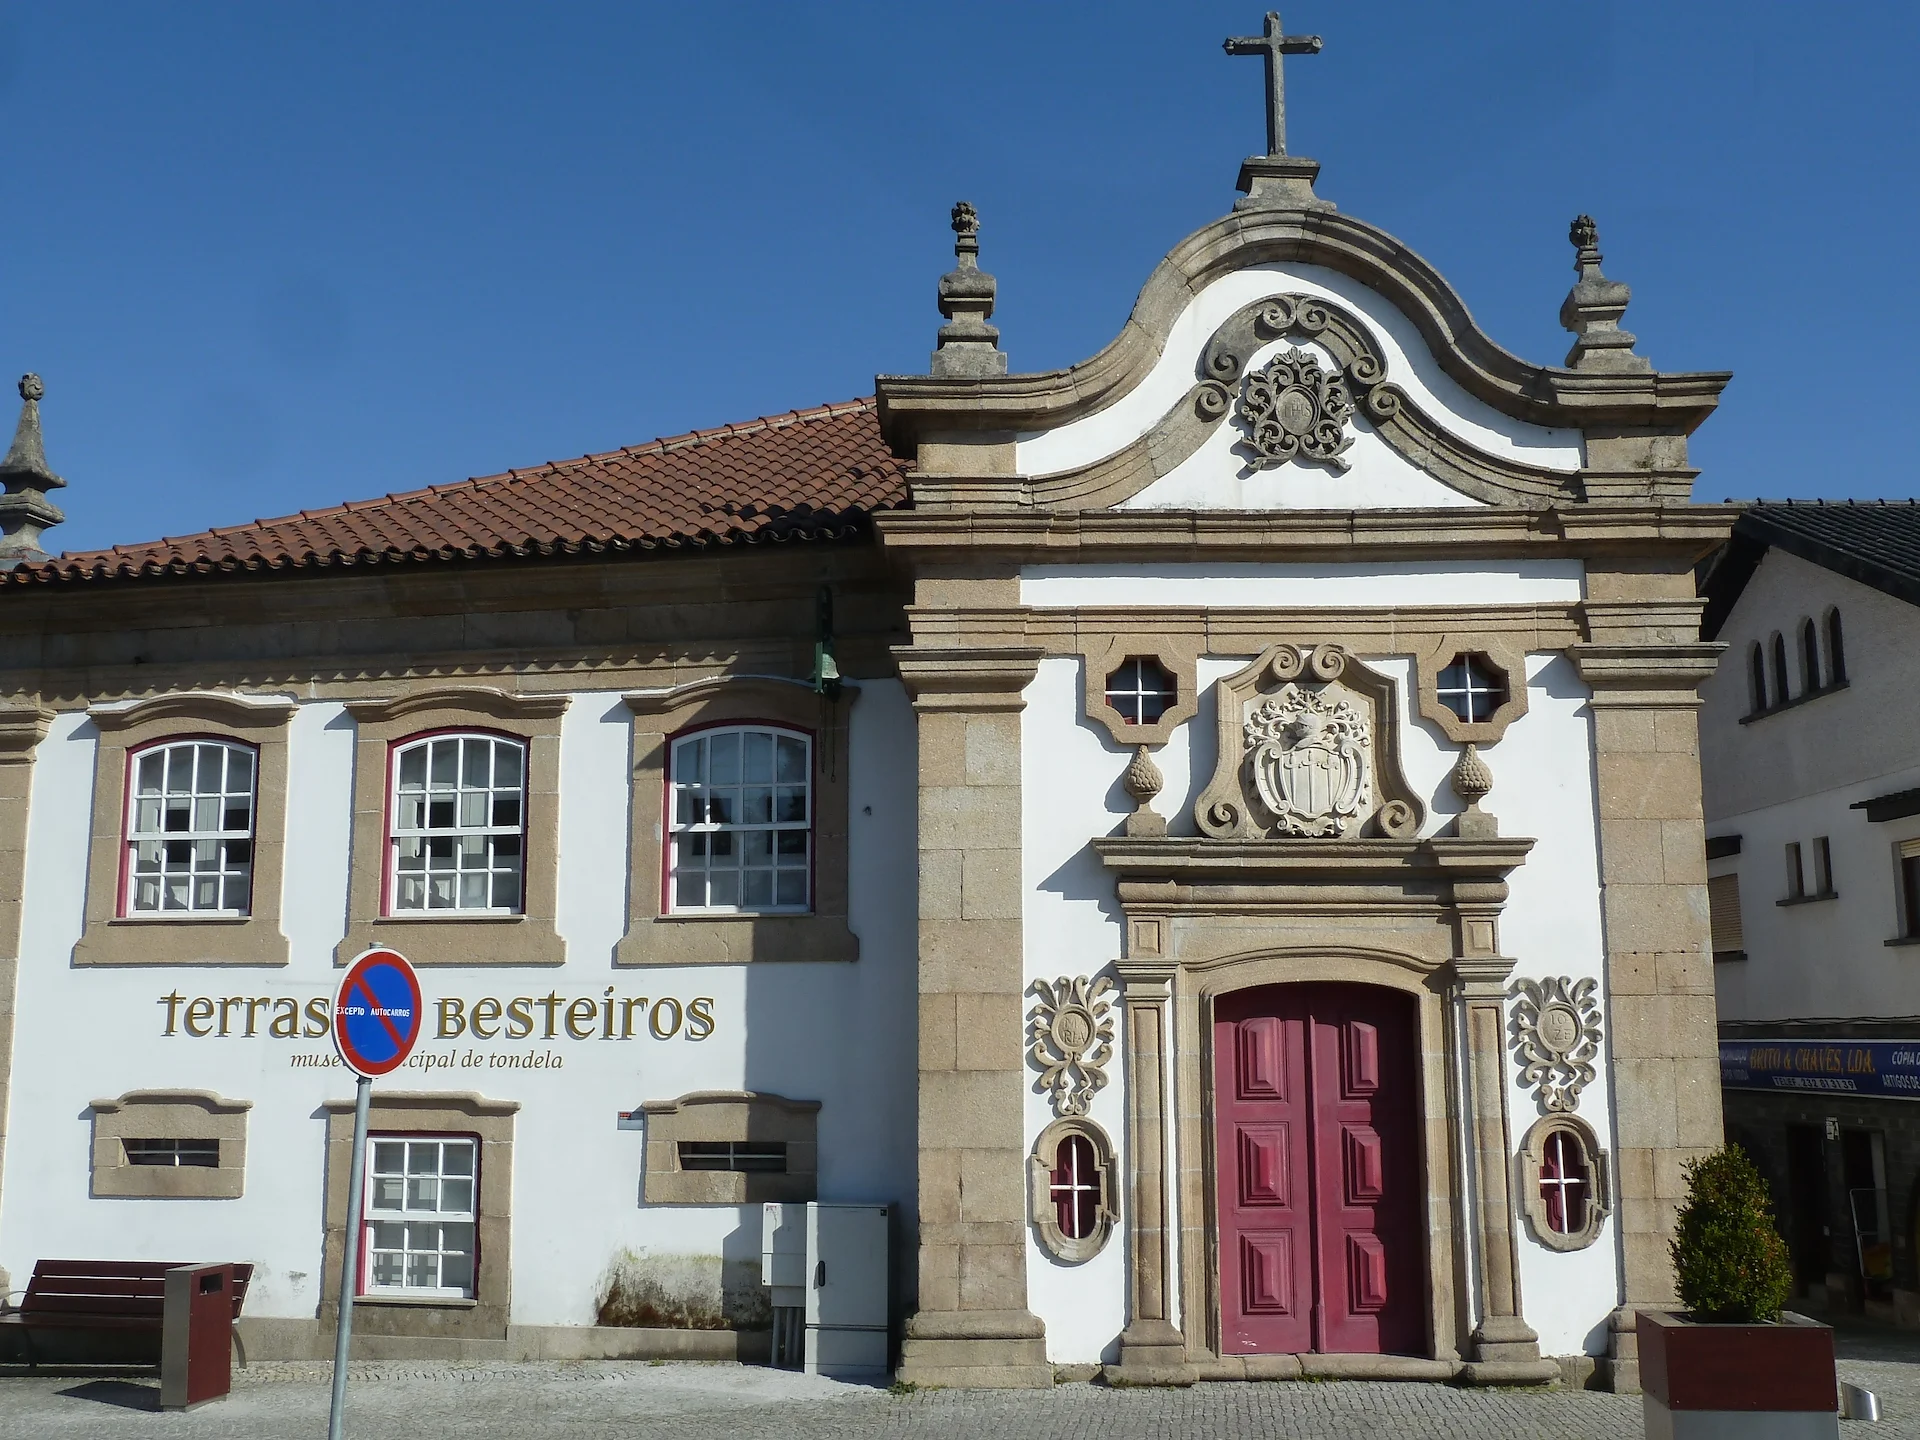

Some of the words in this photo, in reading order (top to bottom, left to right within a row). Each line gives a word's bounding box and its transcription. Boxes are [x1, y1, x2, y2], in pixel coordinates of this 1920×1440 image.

[157, 989, 330, 1038] terras
[433, 986, 715, 1042] Besteiros
[336, 1006, 365, 1016] EXCEPTO
[370, 1007, 410, 1017] AUTOCARROS
[402, 1050, 456, 1073] cipal
[461, 1050, 483, 1068] de
[489, 1050, 563, 1069] tondela
[1750, 1047, 1781, 1070] BRITO
[1783, 1048, 1792, 1070] &
[1847, 1049, 1876, 1073] LDA.
[1891, 1045, 1915, 1066] CÓPIA
[1801, 1078, 1817, 1087] 232
[1843, 1080, 1854, 1089] 39
